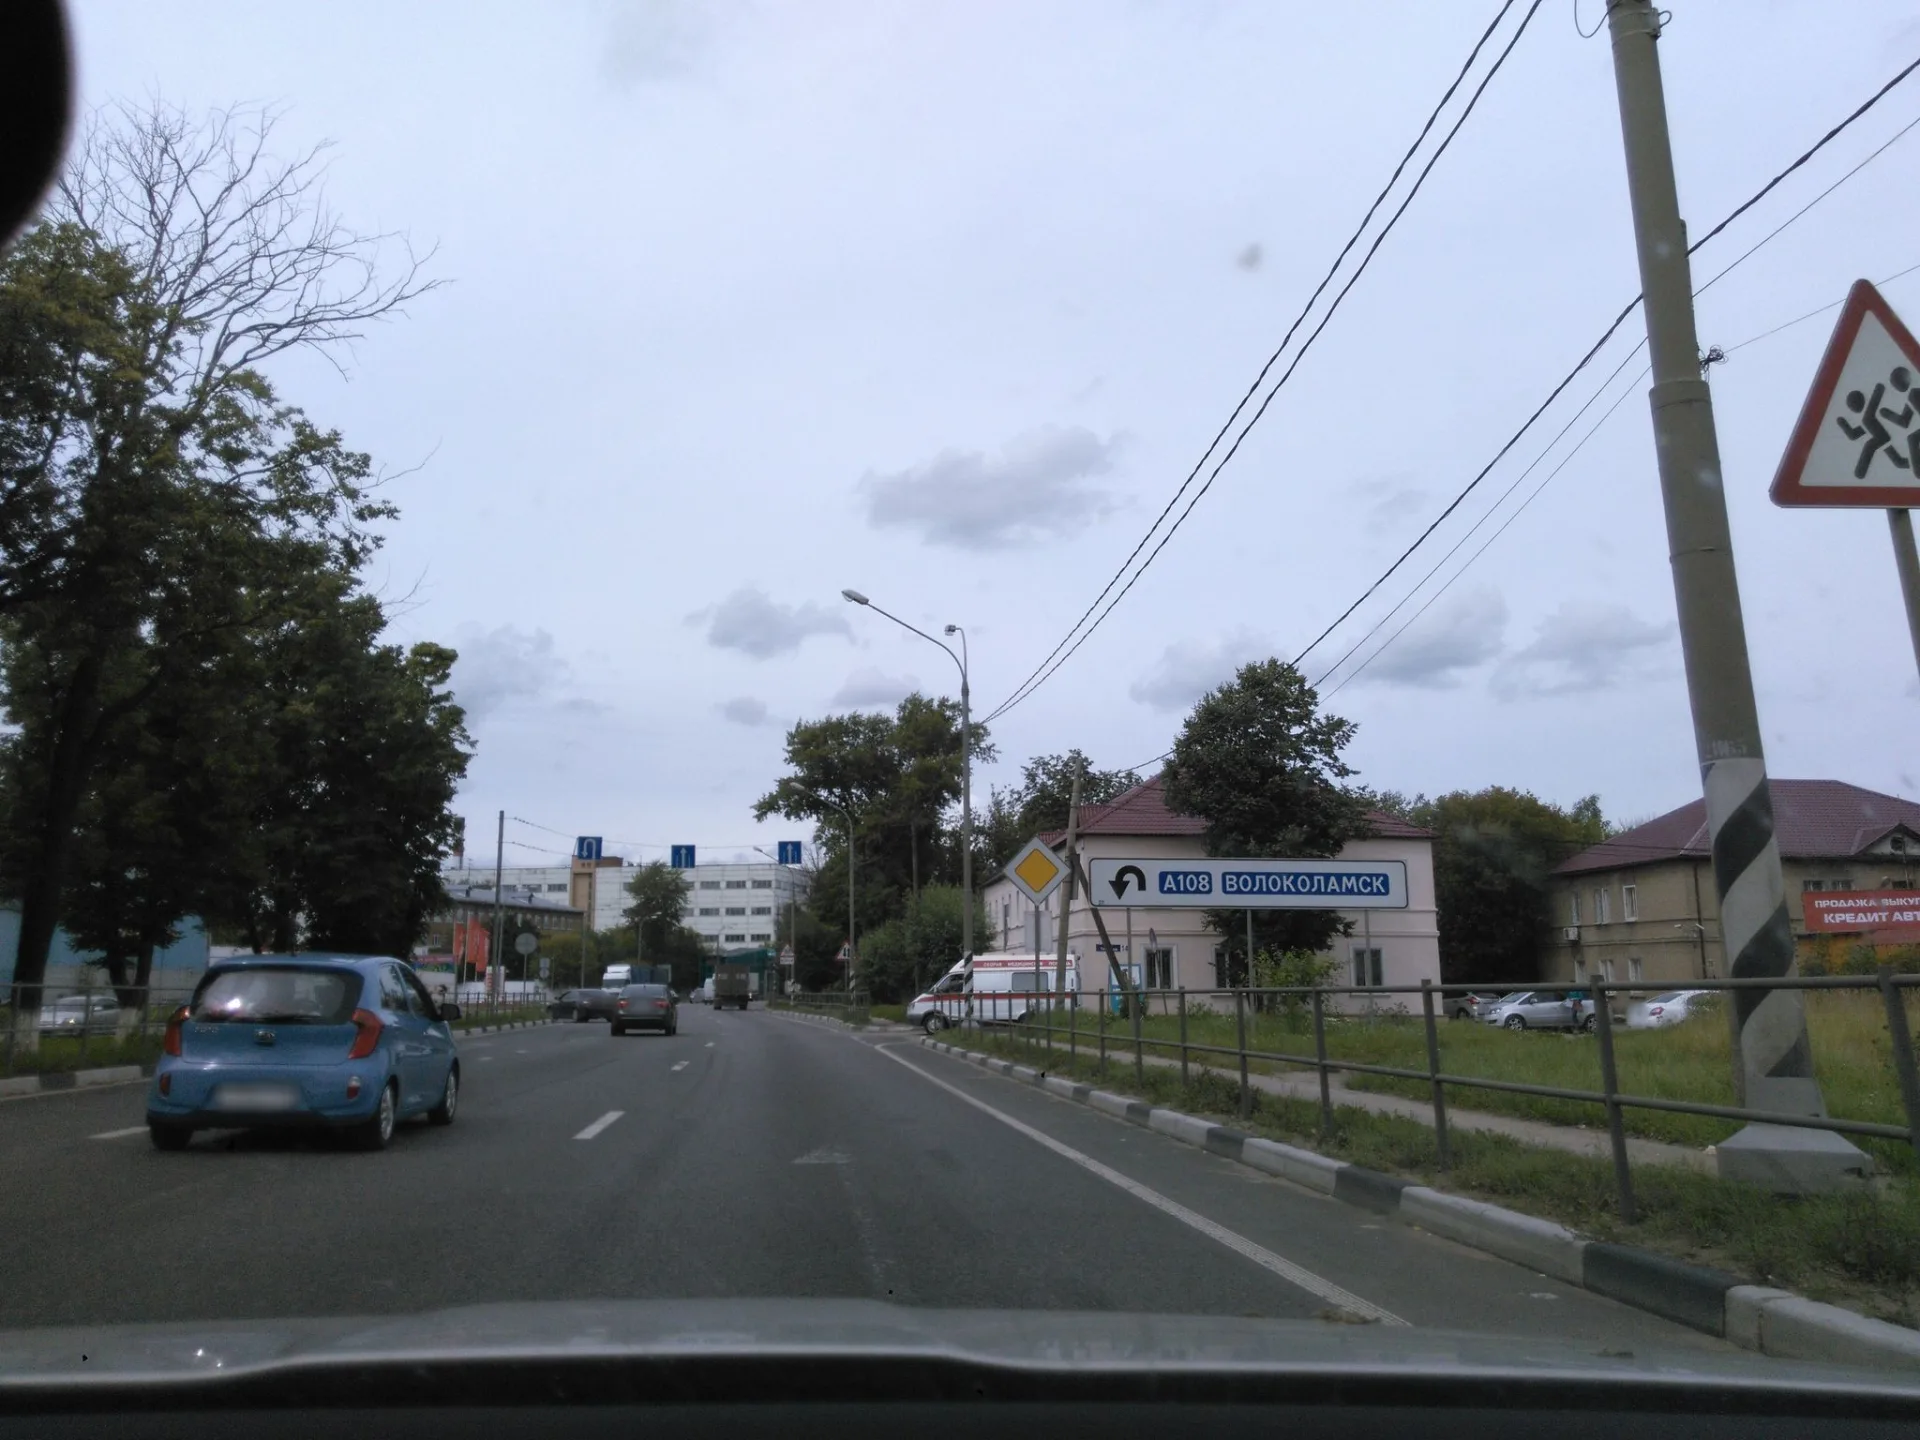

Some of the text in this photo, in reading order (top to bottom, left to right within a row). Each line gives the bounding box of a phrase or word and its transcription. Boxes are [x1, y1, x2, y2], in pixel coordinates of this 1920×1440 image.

[1163, 874, 1210, 891] А108
[1225, 874, 1385, 893] ВОЛОКОЛАМСК
[1815, 899, 1876, 908] ПРОДАЖА
[1824, 912, 1889, 923] КРЕДИТ
